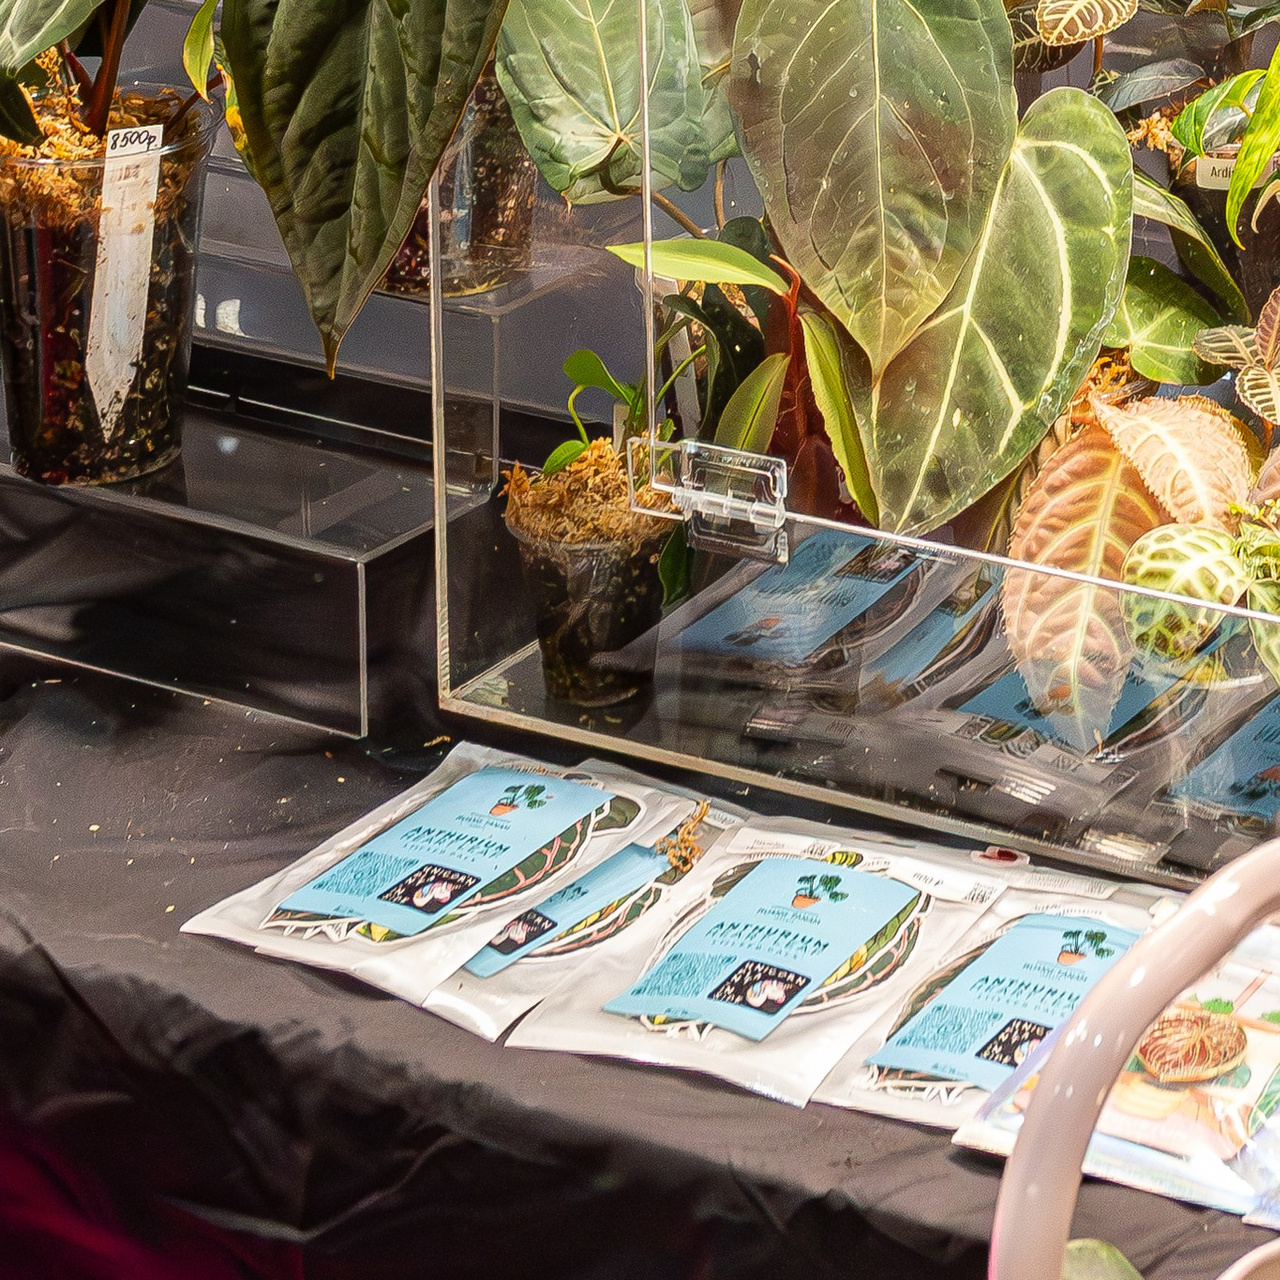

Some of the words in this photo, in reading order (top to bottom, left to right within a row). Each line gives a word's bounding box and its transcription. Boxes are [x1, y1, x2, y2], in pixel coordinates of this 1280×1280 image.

[409, 825, 511, 853] ANTHURIUM
[713, 921, 830, 952] ANTHURIUM
[978, 975, 1081, 1001] ANTHURIU
